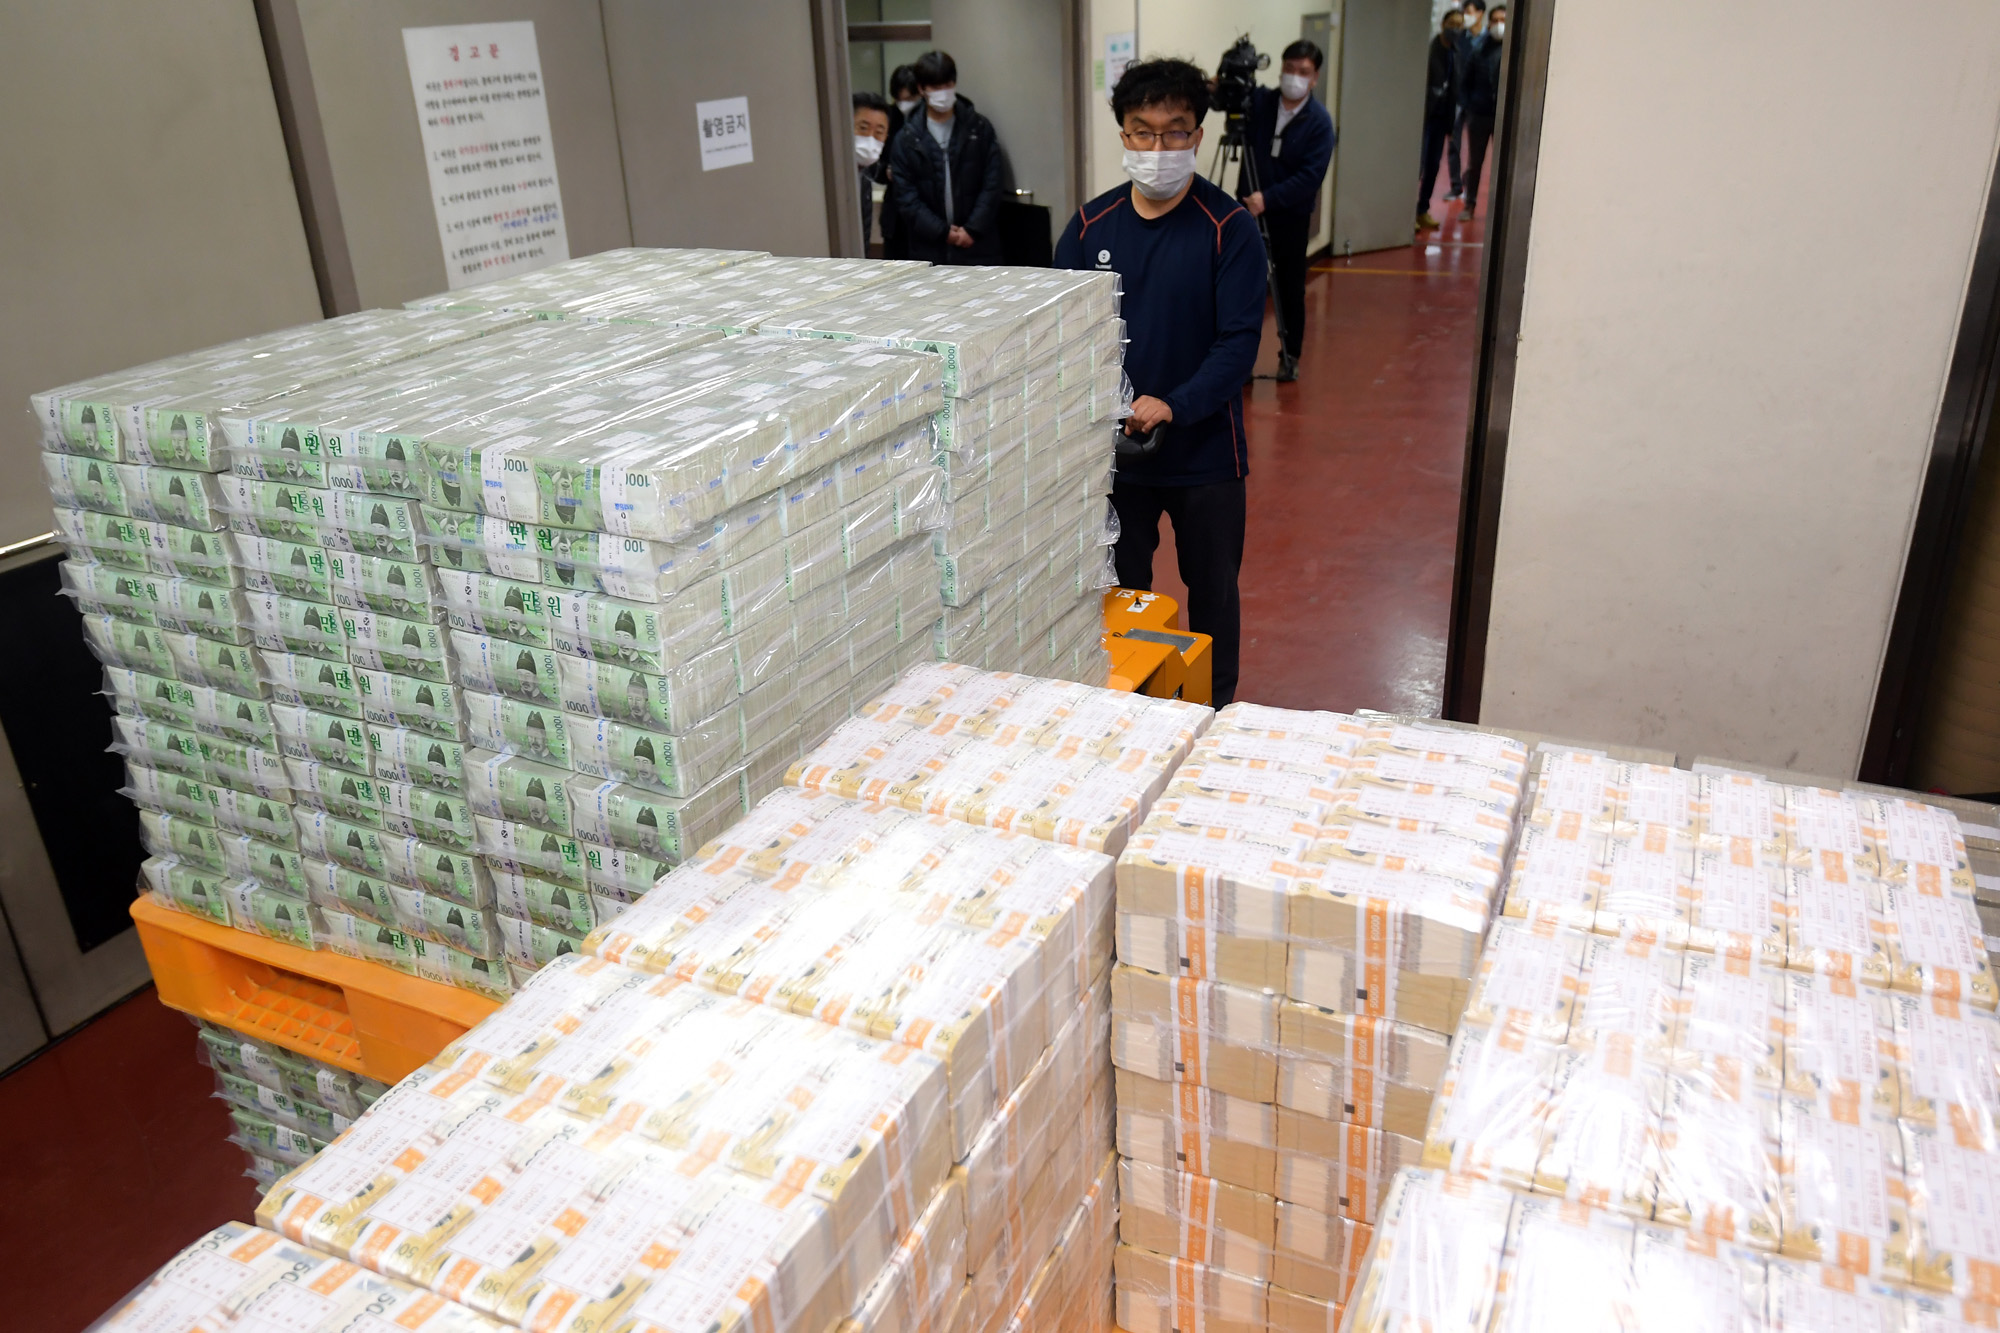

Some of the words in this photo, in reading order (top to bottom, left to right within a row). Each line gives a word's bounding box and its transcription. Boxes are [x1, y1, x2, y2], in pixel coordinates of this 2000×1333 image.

[703, 113, 746, 138] 촬영금지
[624, 539, 645, 553] 100
[336, 593, 350, 605] 100
[351, 653, 365, 665] 100
[565, 700, 589, 714] 1000
[576, 828, 599, 843] 1000
[594, 883, 610, 896] 100
